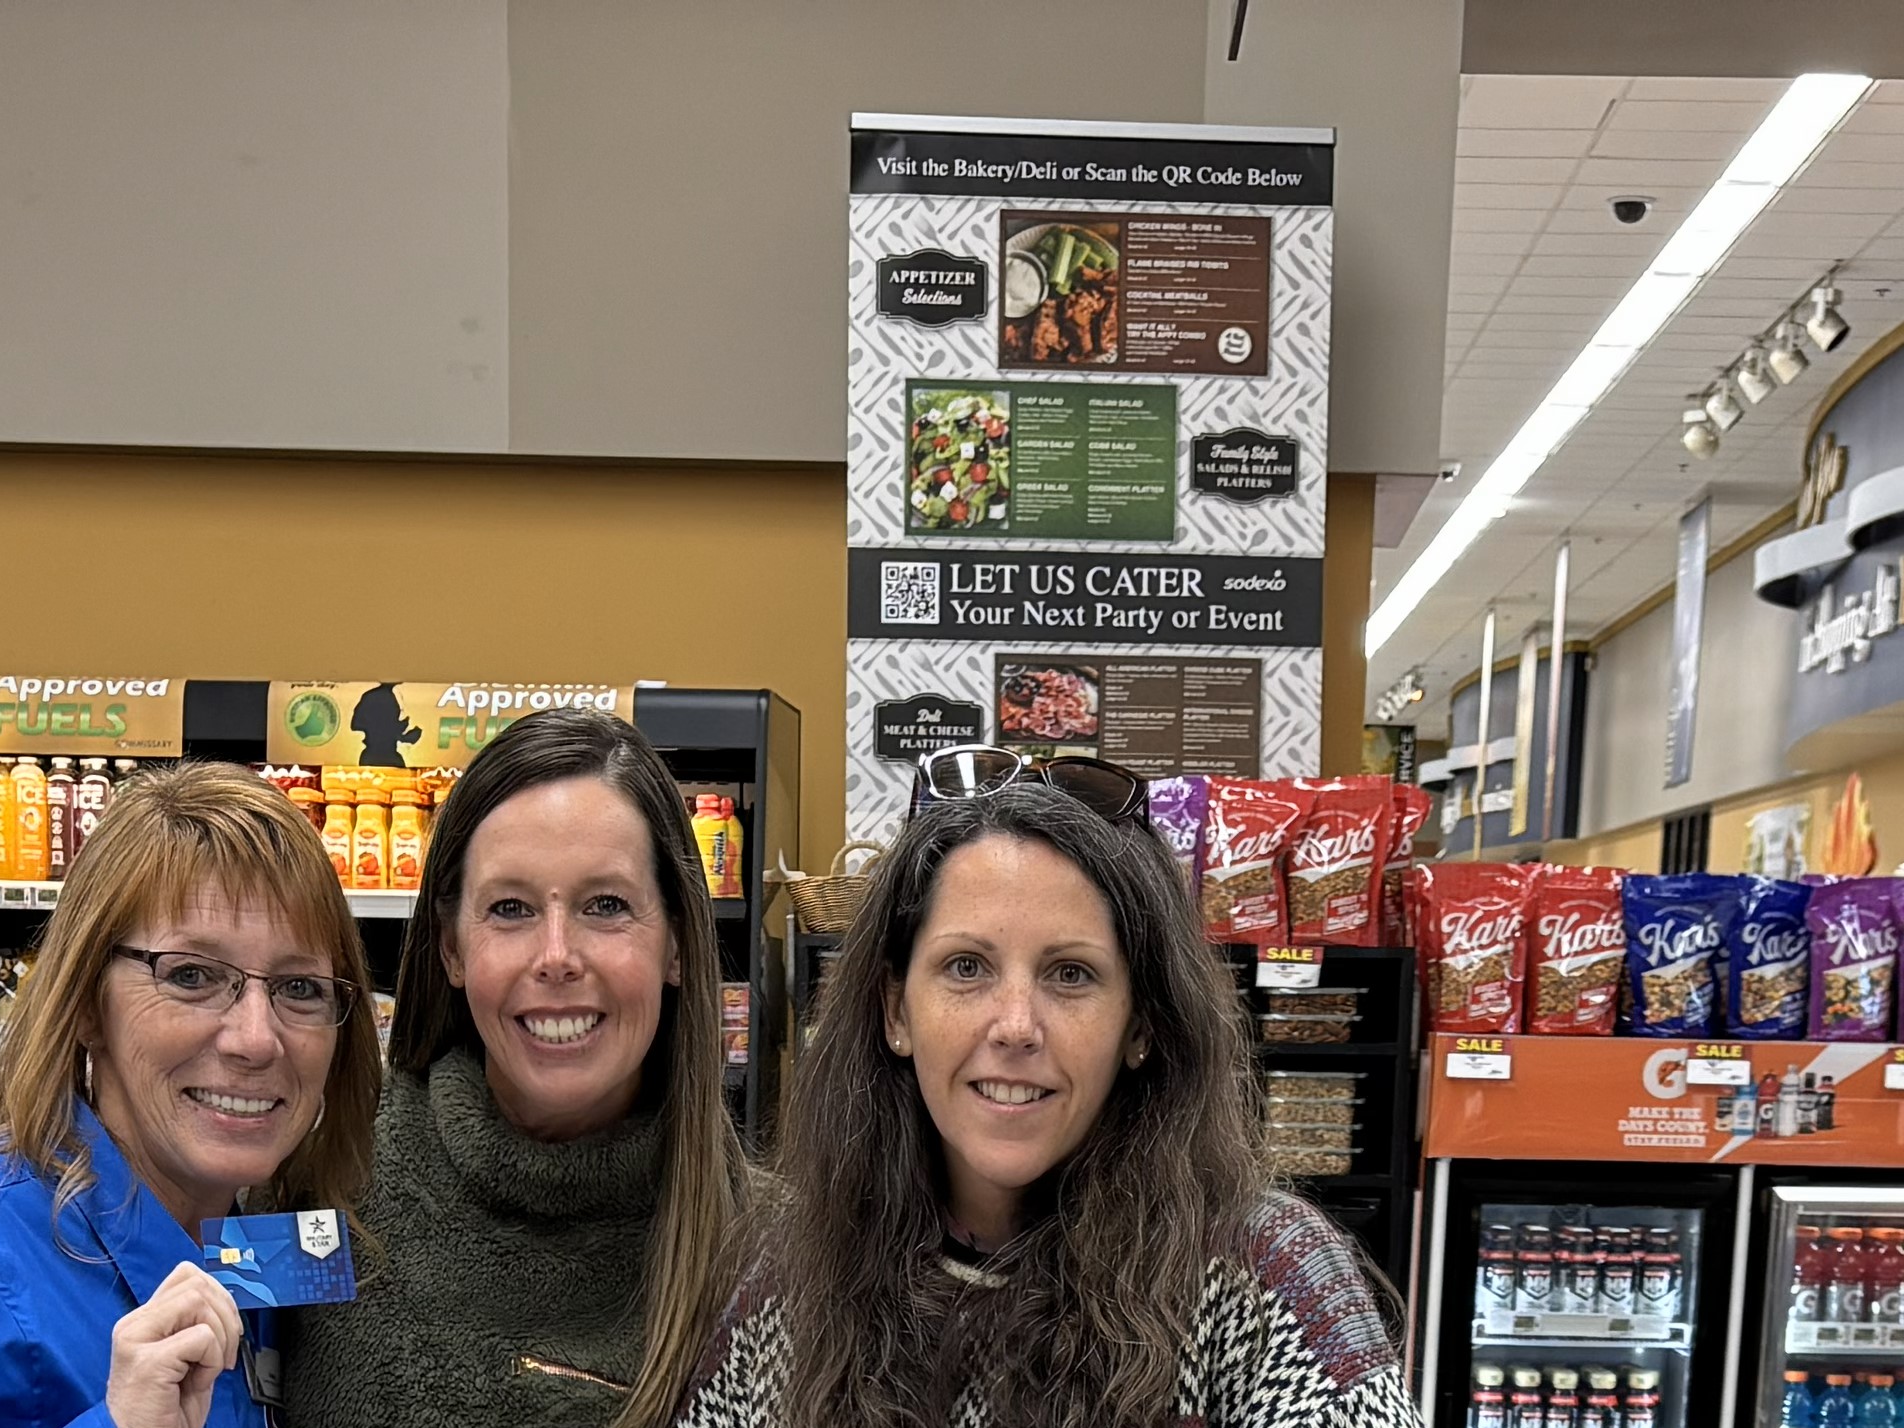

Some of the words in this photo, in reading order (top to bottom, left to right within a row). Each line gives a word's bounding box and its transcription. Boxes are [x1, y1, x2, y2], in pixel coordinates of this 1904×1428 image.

[877, 157, 918, 176] Visit
[921, 158, 949, 177] the
[953, 160, 1057, 183] Bakery/Deli
[1062, 165, 1082, 180] or
[1085, 163, 1127, 184] Scan
[1131, 165, 1158, 184] the
[1162, 166, 1193, 187] QR
[1196, 166, 1243, 187] Code
[1247, 168, 1302, 188] Below
[889, 271, 976, 286] APPETIZER
[902, 289, 962, 306] Selections
[950, 563, 1018, 594] LET
[1030, 566, 1074, 595] US
[1085, 568, 1204, 598] CATER
[1223, 569, 1286, 591] sodexo
[951, 601, 1014, 626] Your
[1024, 602, 1085, 627] Next
[1095, 605, 1160, 634] Party
[1172, 611, 1197, 628] or
[1209, 607, 1284, 631] Event
[436, 684, 617, 715] Approved
[917, 709, 942, 723] Deli
[884, 725, 916, 736] MEAT
[930, 726, 975, 737] CHEESE
[1266, 946, 1313, 962] SALE
[1456, 1038, 1502, 1053] SALE
[1696, 1044, 1742, 1059] SALE
[1642, 1048, 1688, 1098] G
